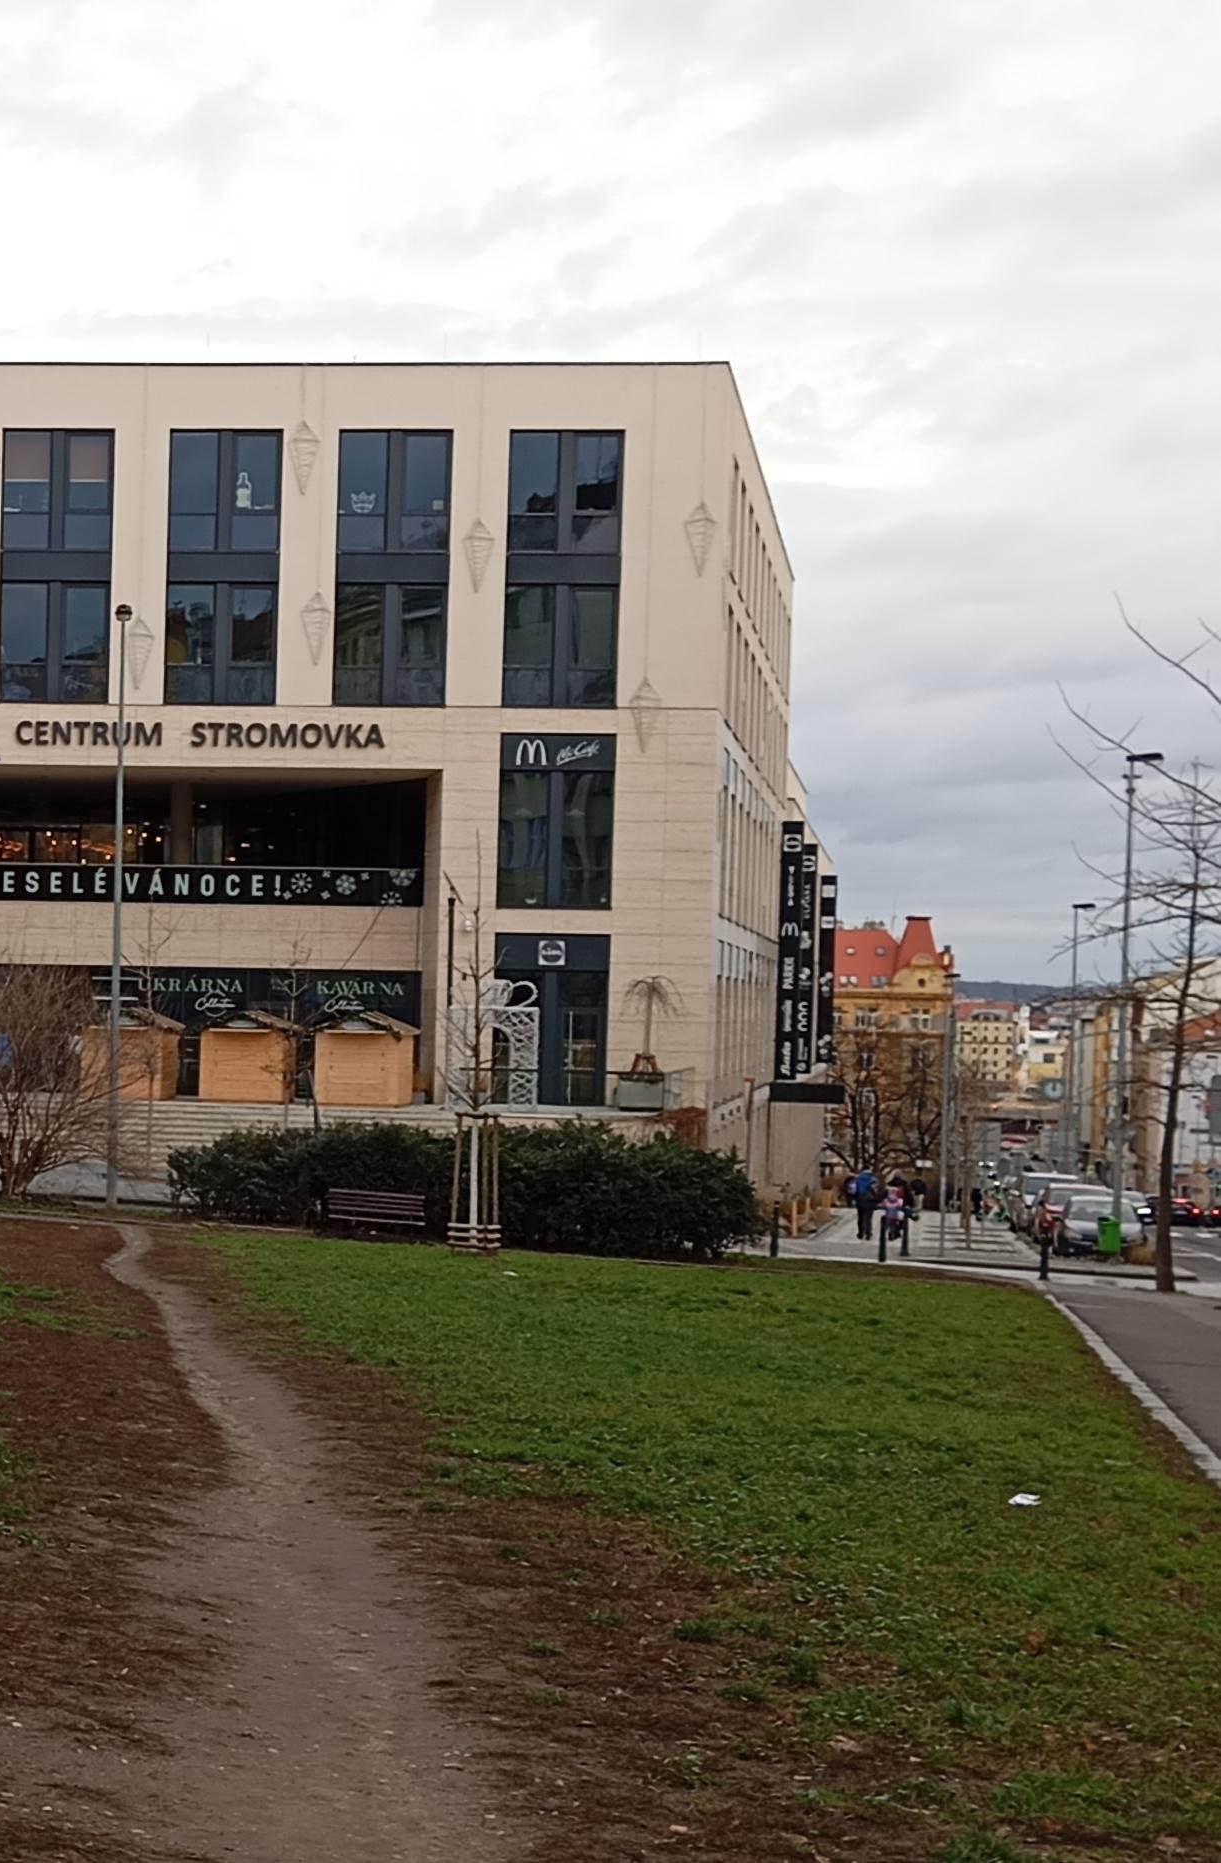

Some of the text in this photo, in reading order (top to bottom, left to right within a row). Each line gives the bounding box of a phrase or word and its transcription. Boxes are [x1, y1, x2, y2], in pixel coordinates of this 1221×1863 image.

[15, 720, 386, 749] CENTRUM STROMOVKA
[124, 868, 282, 897] VÁNOCE!
